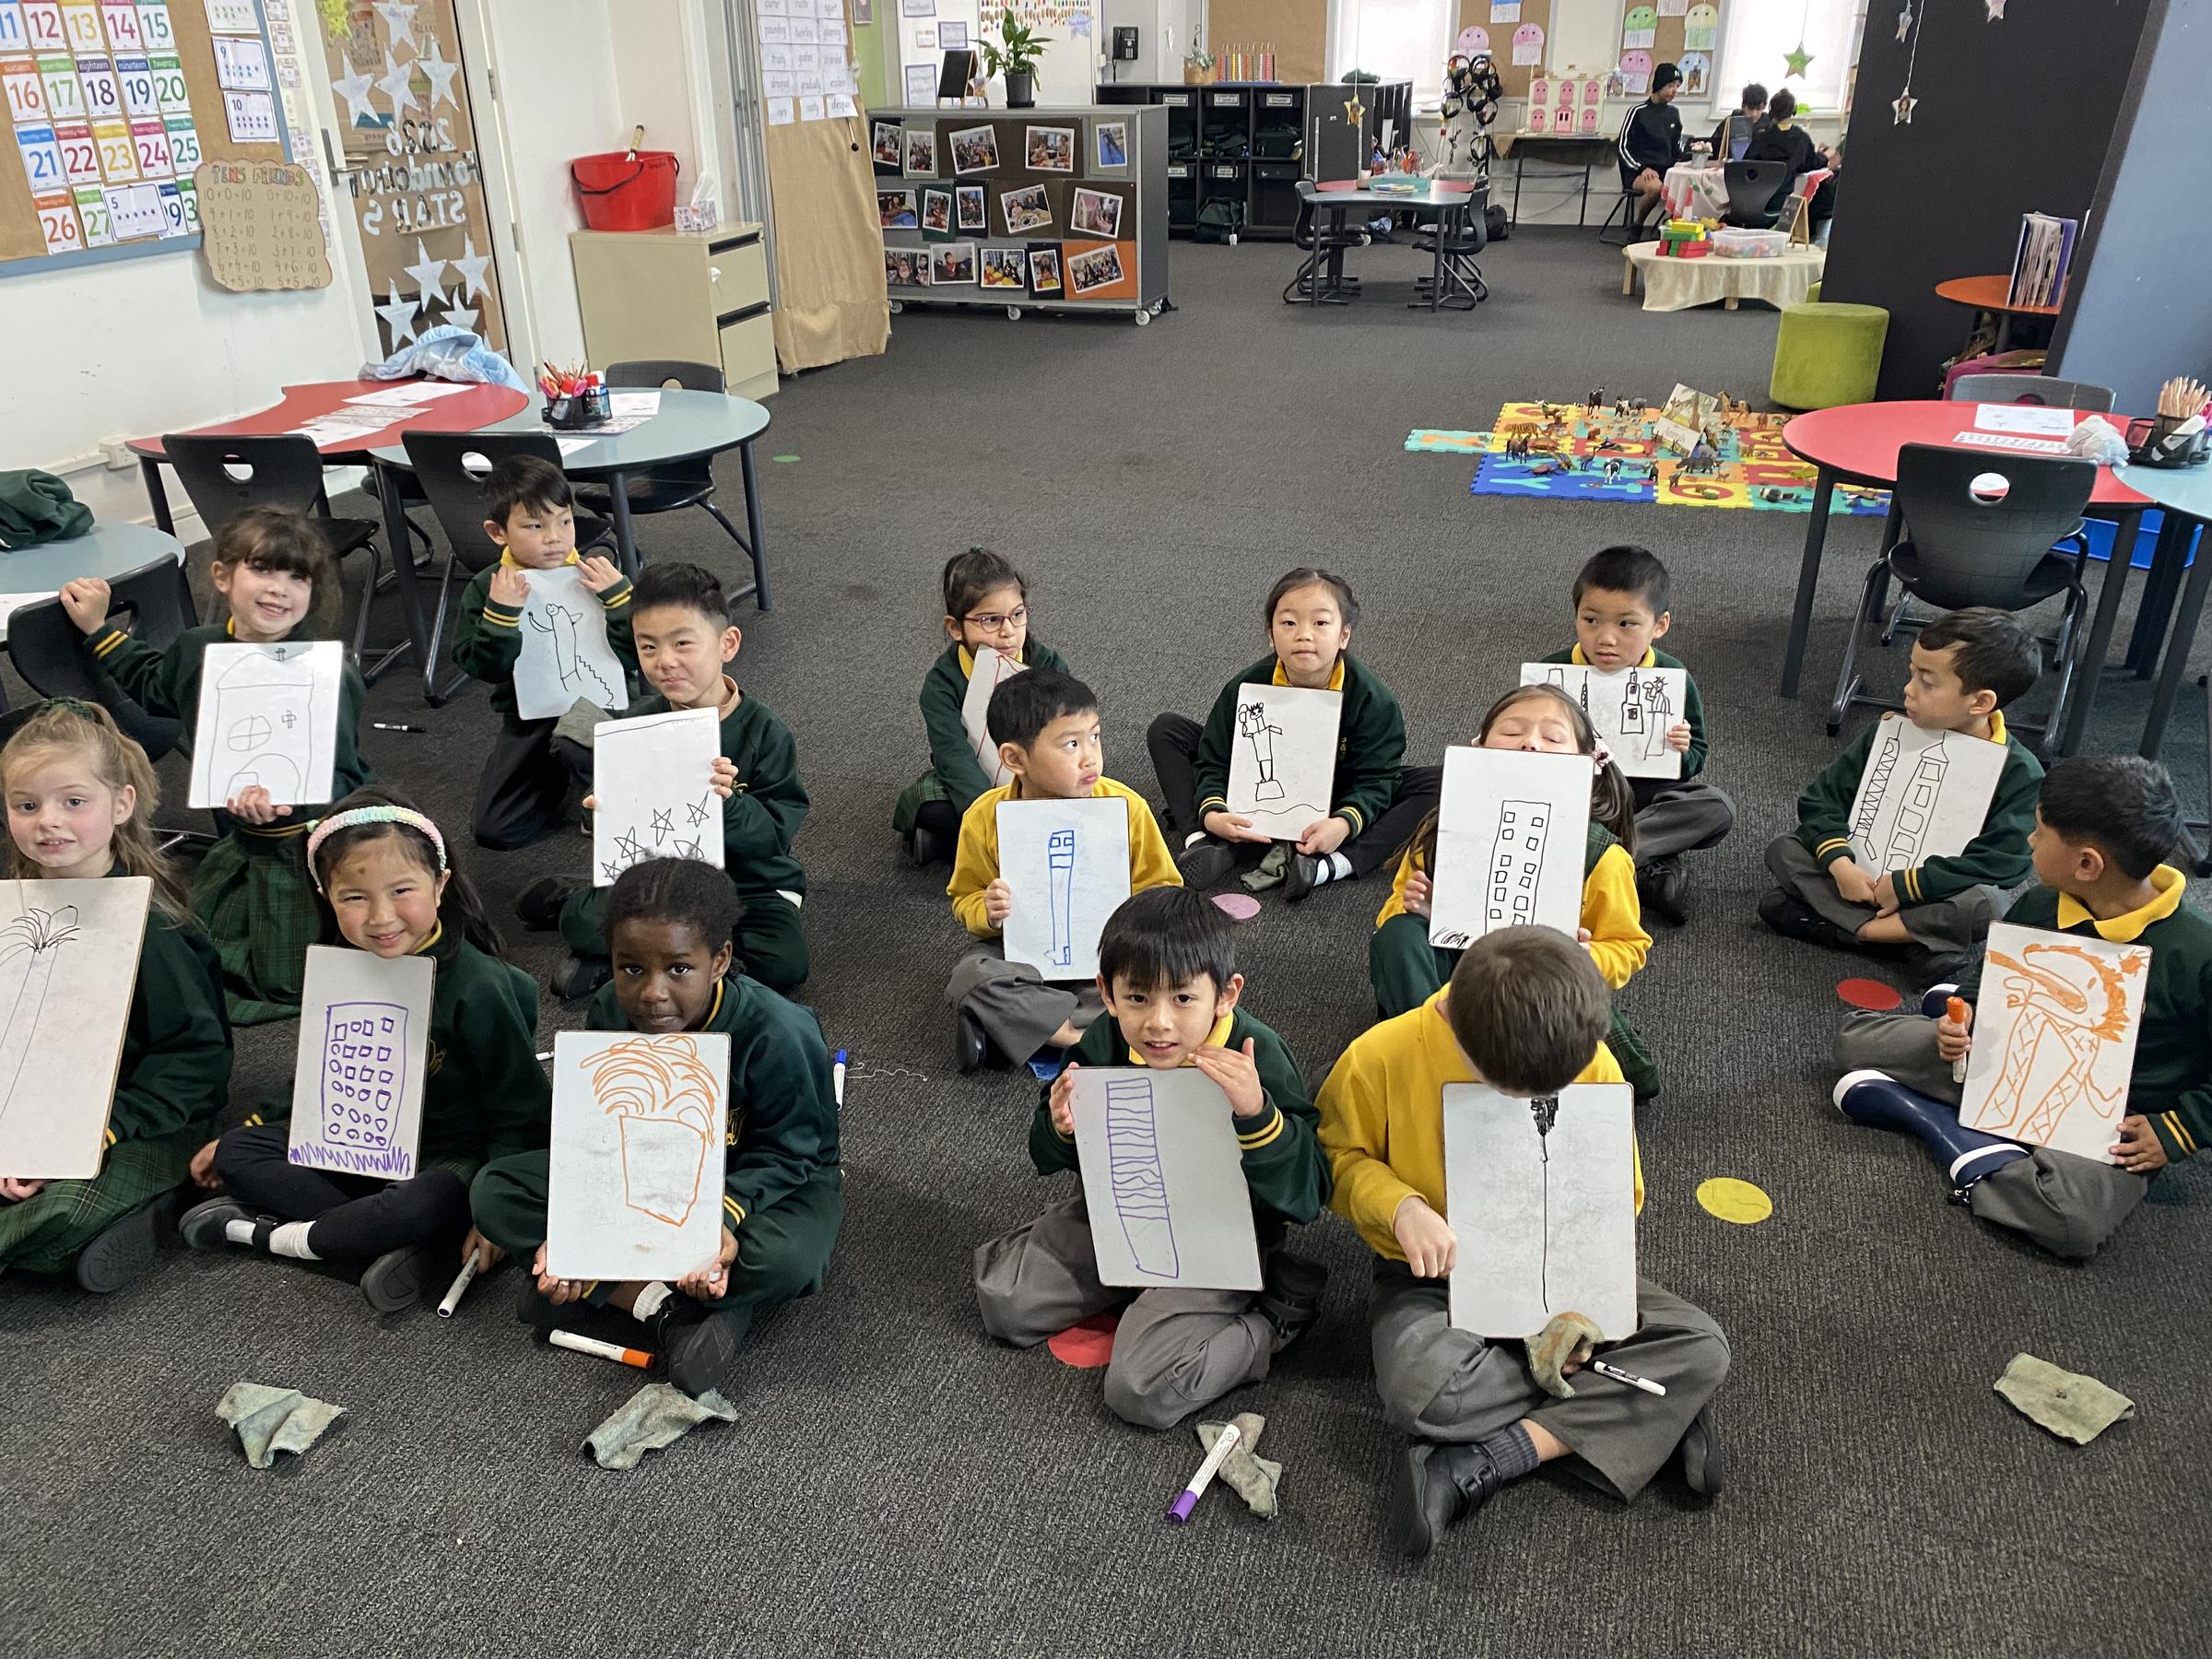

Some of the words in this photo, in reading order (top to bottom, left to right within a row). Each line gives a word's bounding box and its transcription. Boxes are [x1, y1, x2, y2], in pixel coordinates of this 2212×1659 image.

[0, 11, 18, 39] 11
[30, 11, 60, 39] 12
[70, 12, 97, 41] 13
[108, 13, 135, 40] 14
[143, 13, 169, 39] 15
[119, 61, 147, 70] nineteen
[153, 59, 176, 69] twenty
[220, 46, 227, 59] 9
[79, 64, 109, 72] eighteen
[9, 81, 40, 110] 16
[50, 79, 73, 107] 17
[86, 78, 115, 106] 18
[125, 78, 150, 105] 19
[156, 76, 185, 102] 20
[232, 99, 242, 111] 10
[65, 146, 97, 173] 22
[102, 145, 133, 171] 23
[138, 142, 169, 168] 24
[172, 137, 199, 163] 25
[29, 149, 57, 178] 21
[211, 165, 246, 183] TENS
[111, 196, 119, 209] 5
[184, 198, 198, 222] 3
[42, 214, 76, 243] 26
